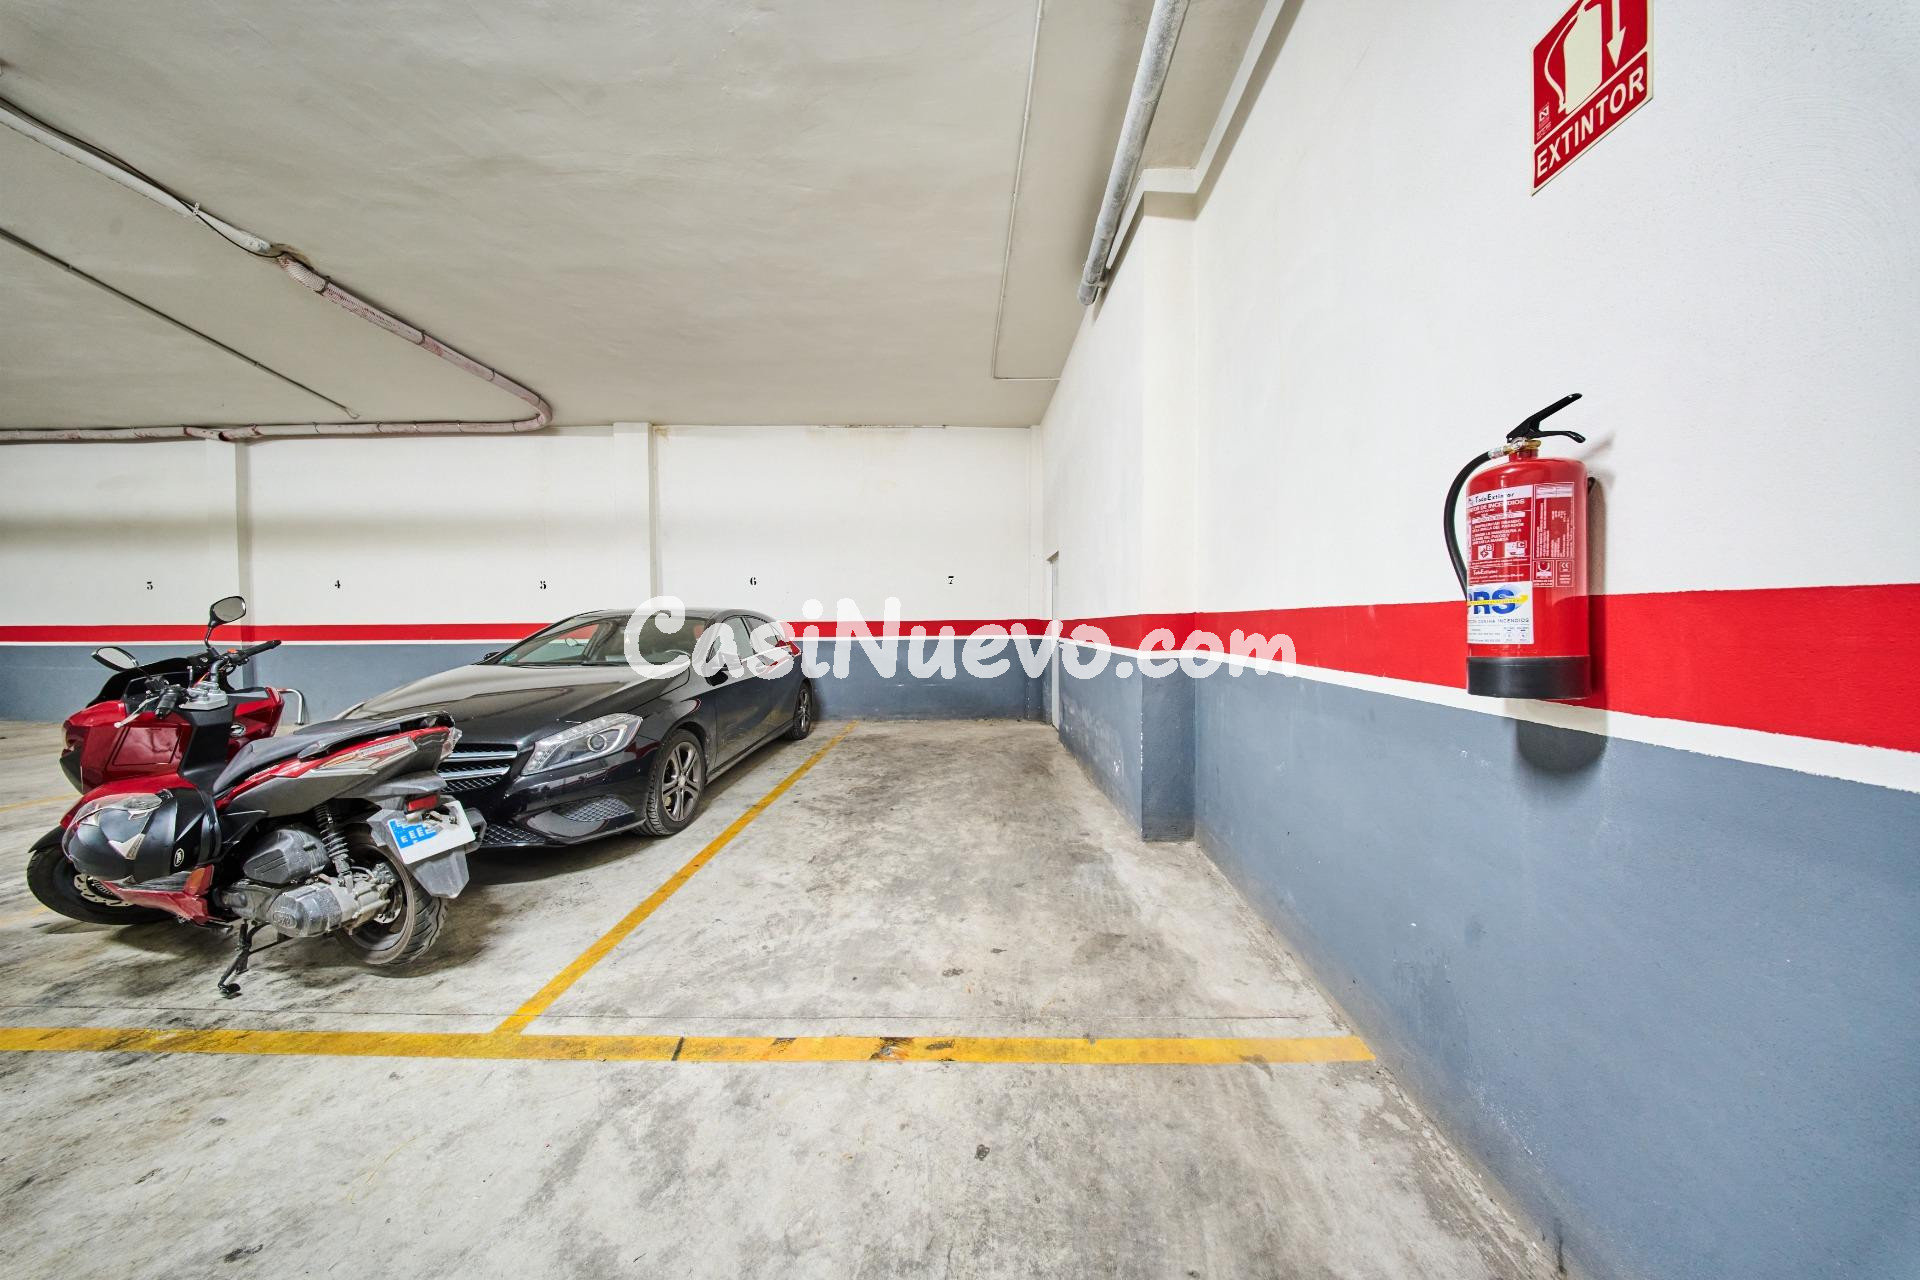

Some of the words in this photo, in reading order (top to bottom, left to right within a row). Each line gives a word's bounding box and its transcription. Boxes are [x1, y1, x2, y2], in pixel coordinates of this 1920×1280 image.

[1536, 66, 1646, 178] EXTINTOR
[1475, 493, 1515, 503] TodoExtinor
[1488, 499, 1526, 509] INCEDIOS
[334, 580, 341, 589] 4
[539, 580, 547, 590] 5
[749, 577, 757, 586] 6
[947, 575, 955, 585] 7
